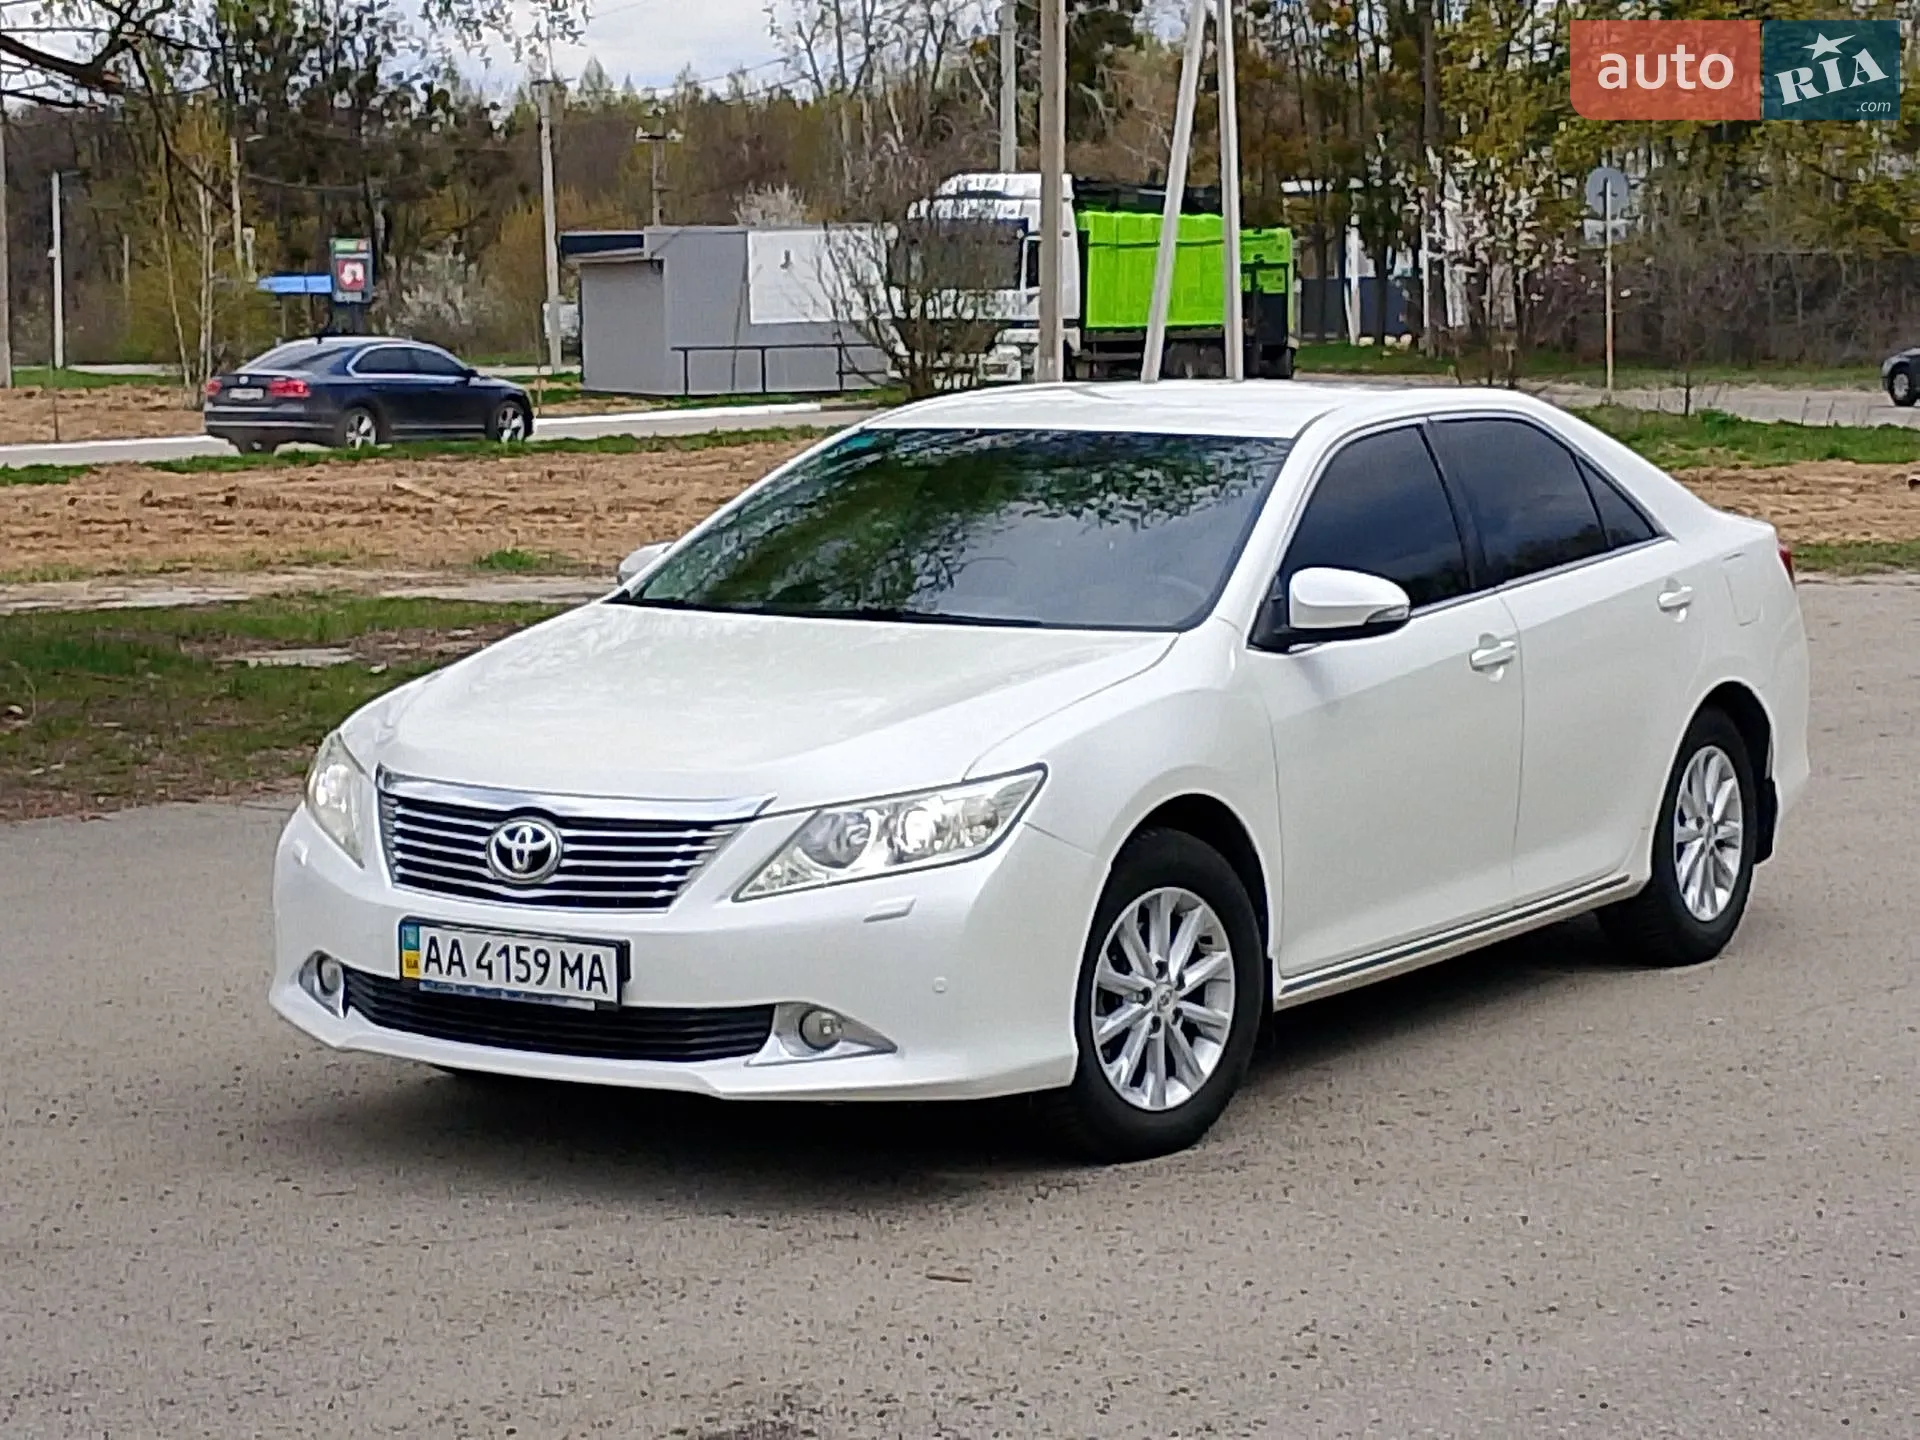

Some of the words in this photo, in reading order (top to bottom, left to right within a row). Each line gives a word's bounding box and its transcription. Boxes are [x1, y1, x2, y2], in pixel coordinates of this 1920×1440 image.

[424, 935, 467, 978] AA
[476, 941, 551, 986] 4159
[560, 949, 608, 994] MA
